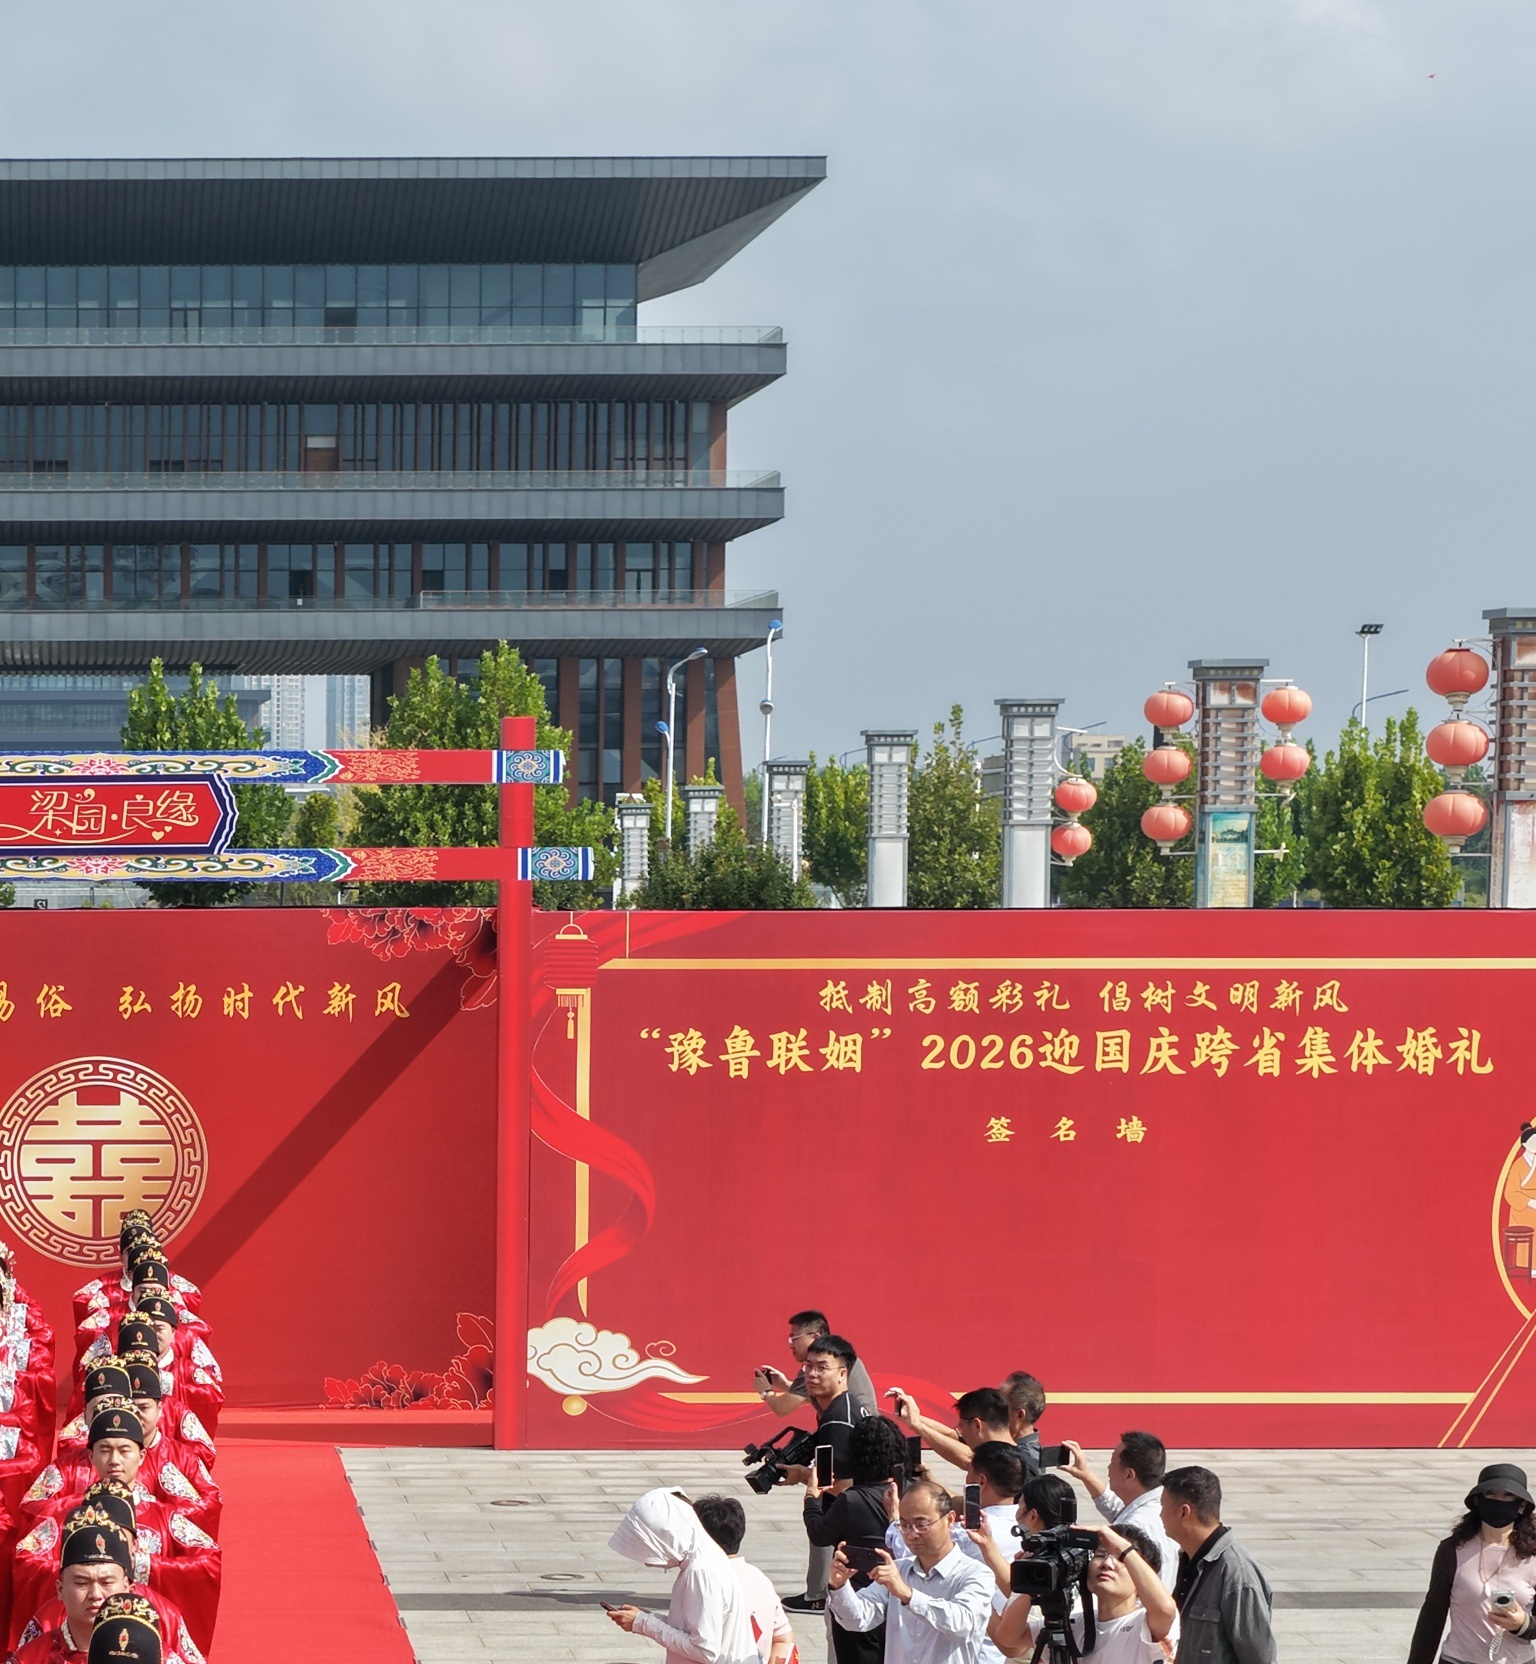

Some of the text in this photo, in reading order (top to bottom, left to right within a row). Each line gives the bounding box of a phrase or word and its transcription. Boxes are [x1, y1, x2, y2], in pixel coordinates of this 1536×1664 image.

[118, 980, 410, 1023] 弘扬时代新风
[818, 978, 1350, 1017] 抵制高额彩礼 倡树文明新风
[639, 1024, 1495, 1080] “豫鲁联姻” 2026迎国庆跨省集体婚礼
